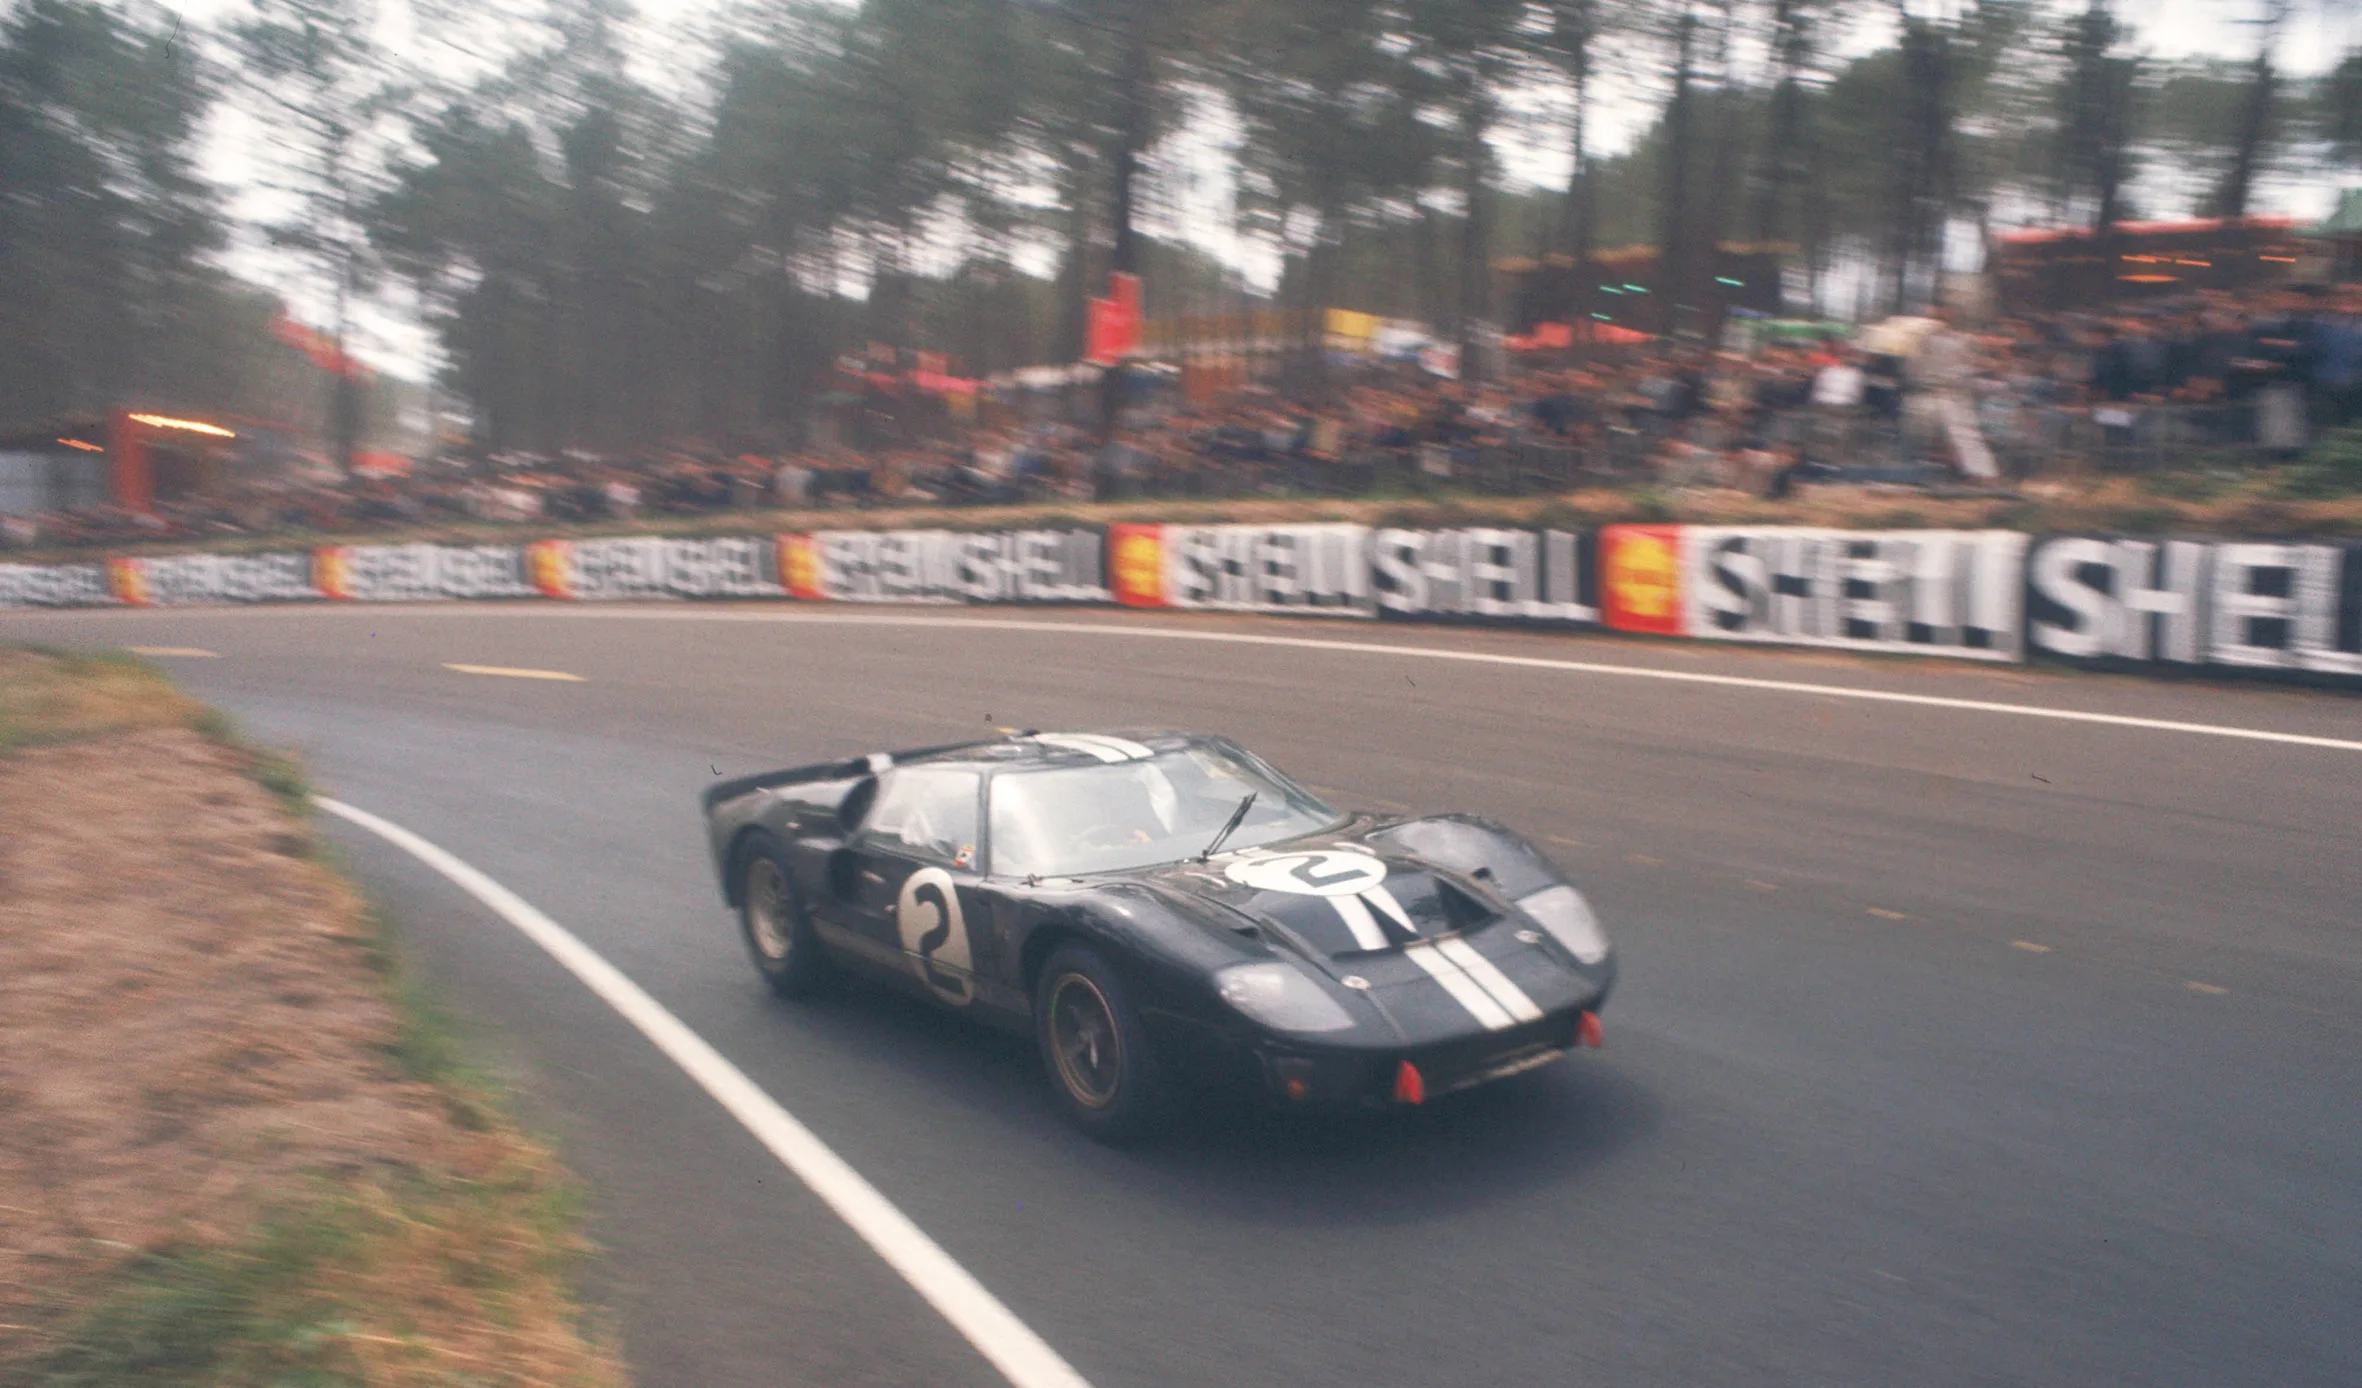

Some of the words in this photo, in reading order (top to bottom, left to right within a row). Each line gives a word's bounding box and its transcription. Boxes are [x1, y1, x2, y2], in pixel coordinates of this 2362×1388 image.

[1180, 530, 1380, 612] SHELL
[1374, 527, 1601, 620] SHELL
[1705, 536, 2022, 648] SHELL
[1248, 855, 1372, 888] 2
[914, 882, 968, 997] 2
